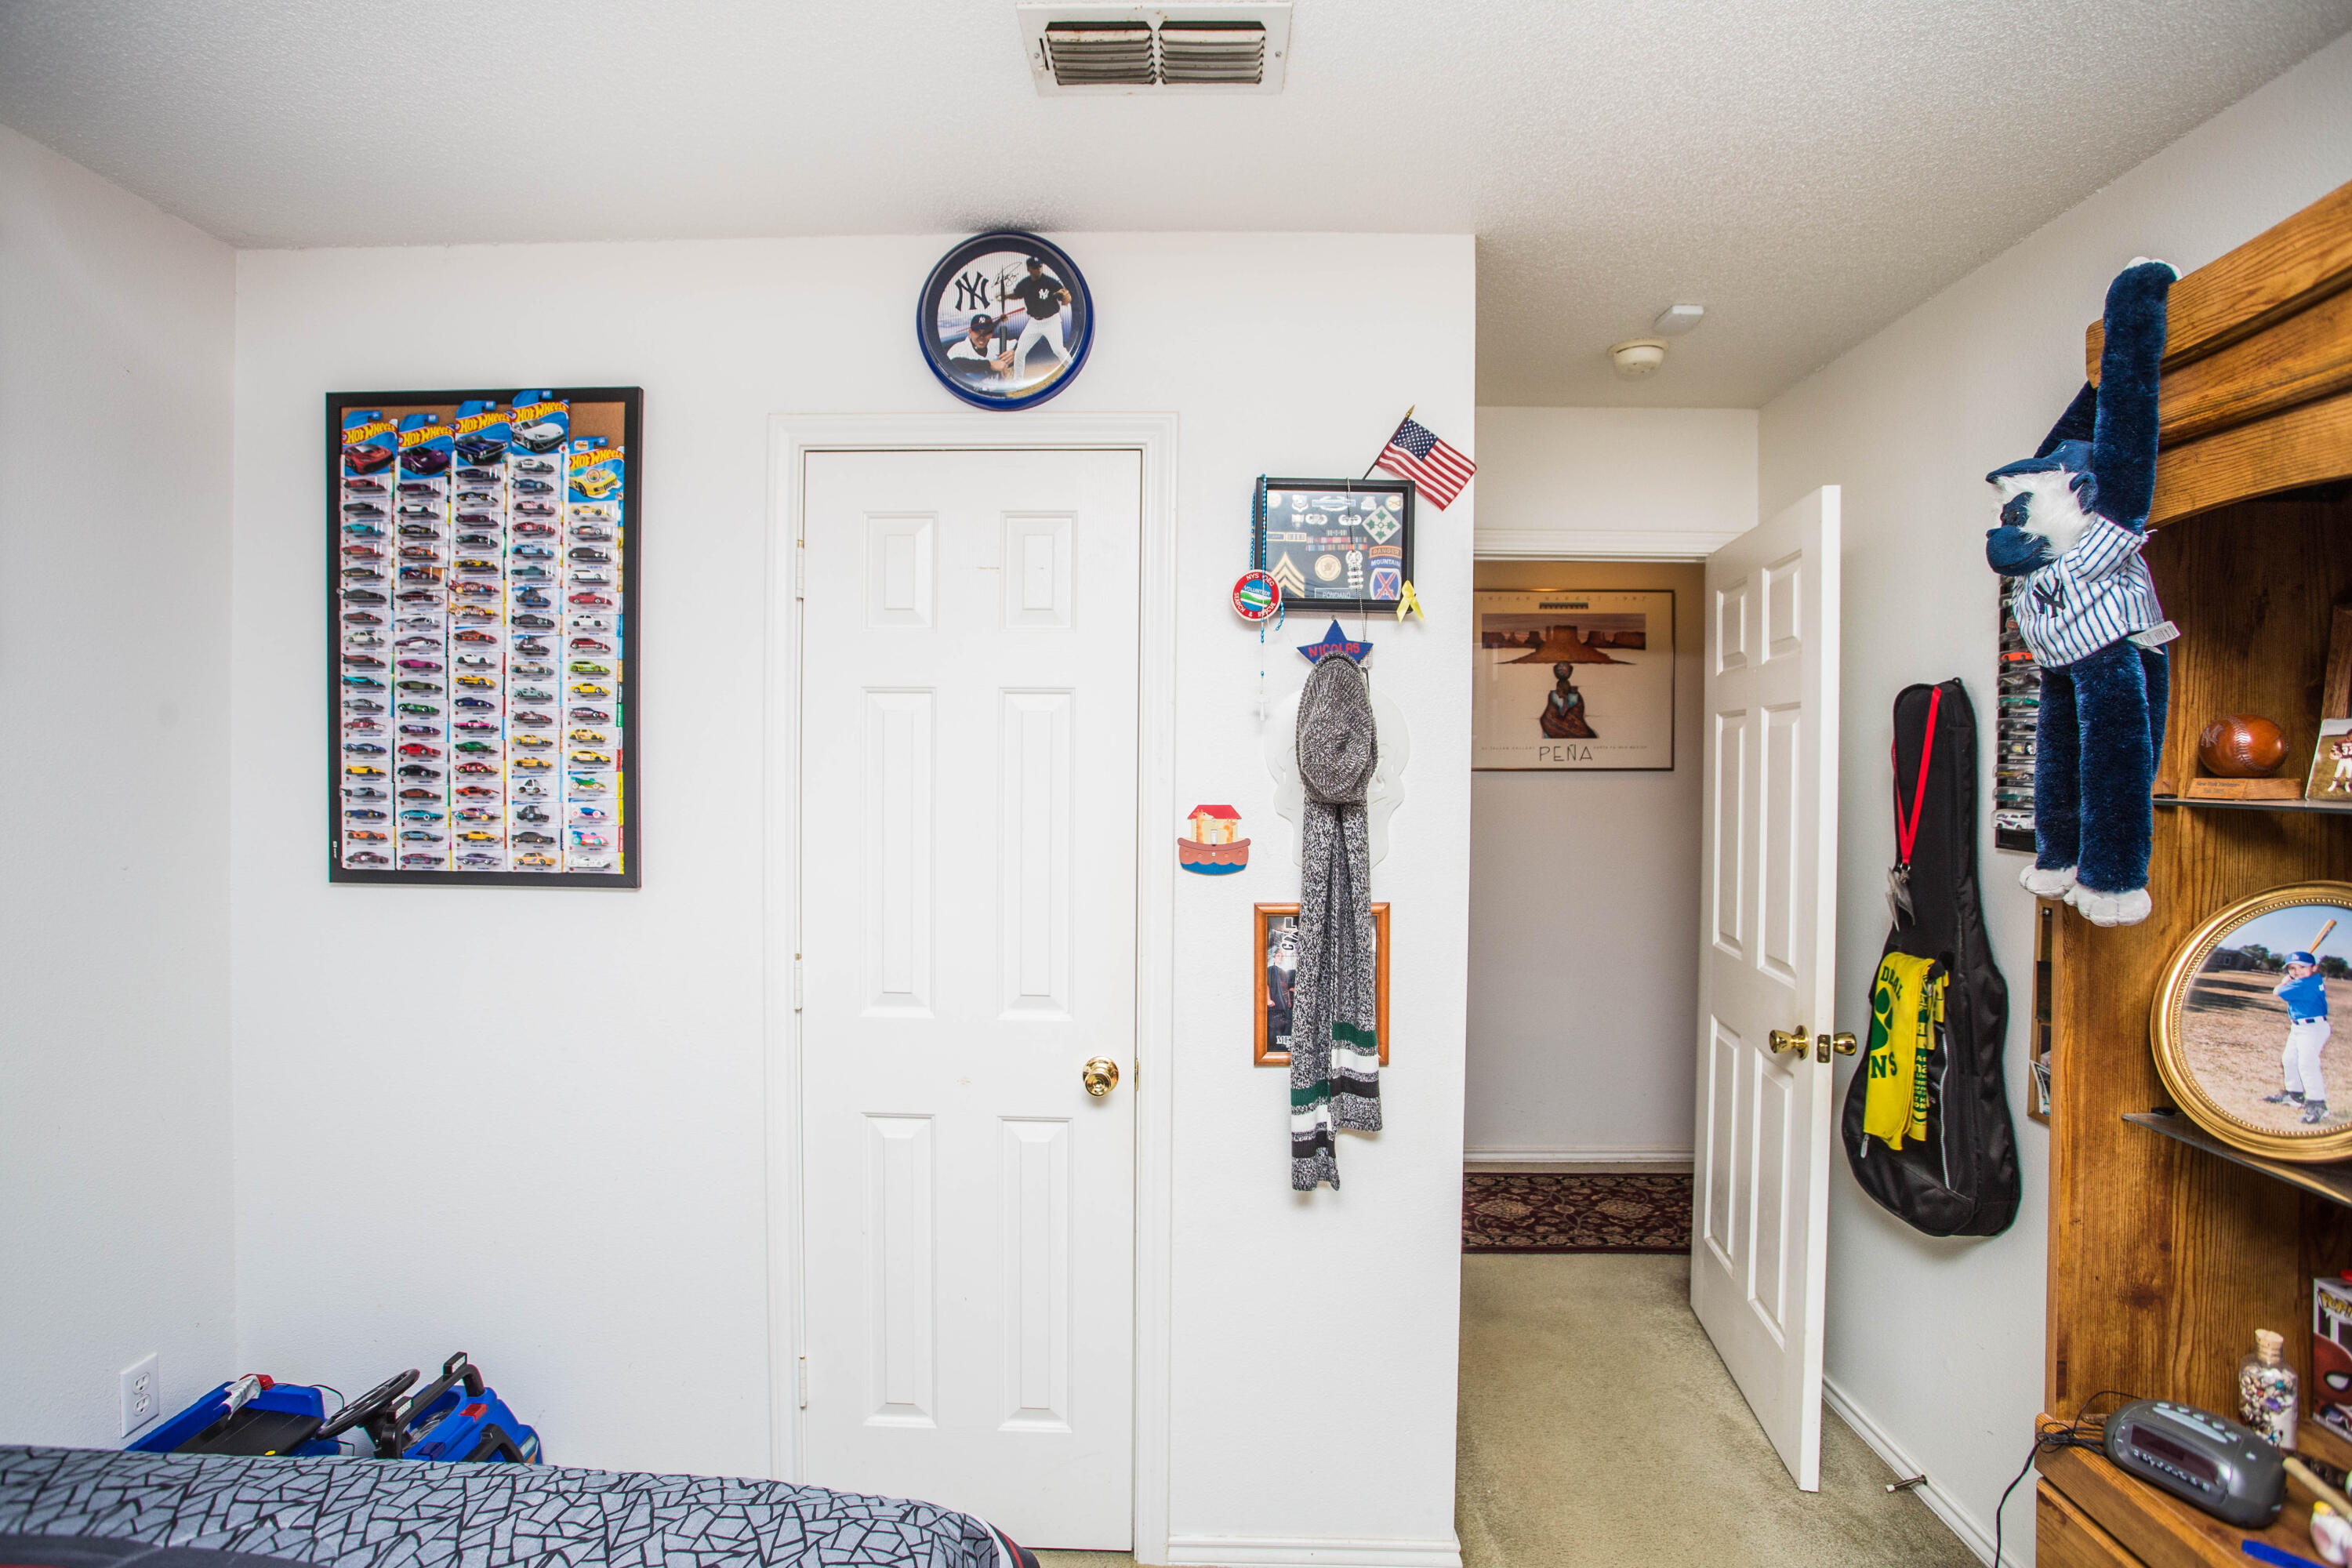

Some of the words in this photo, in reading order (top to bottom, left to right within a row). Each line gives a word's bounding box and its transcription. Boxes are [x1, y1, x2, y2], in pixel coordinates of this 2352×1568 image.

[955, 270, 991, 311] NY
[459, 417, 478, 434] HOT
[345, 428, 365, 445] HOT
[401, 432, 421, 447] HOT
[571, 454, 592, 470] HOT
[1246, 572, 1260, 581] NYS
[1234, 592, 1246, 612] SEARCH
[2032, 577, 2067, 619] NY
[1308, 641, 1361, 658] NICOLAS
[1539, 742, 1594, 762] PEÑA
